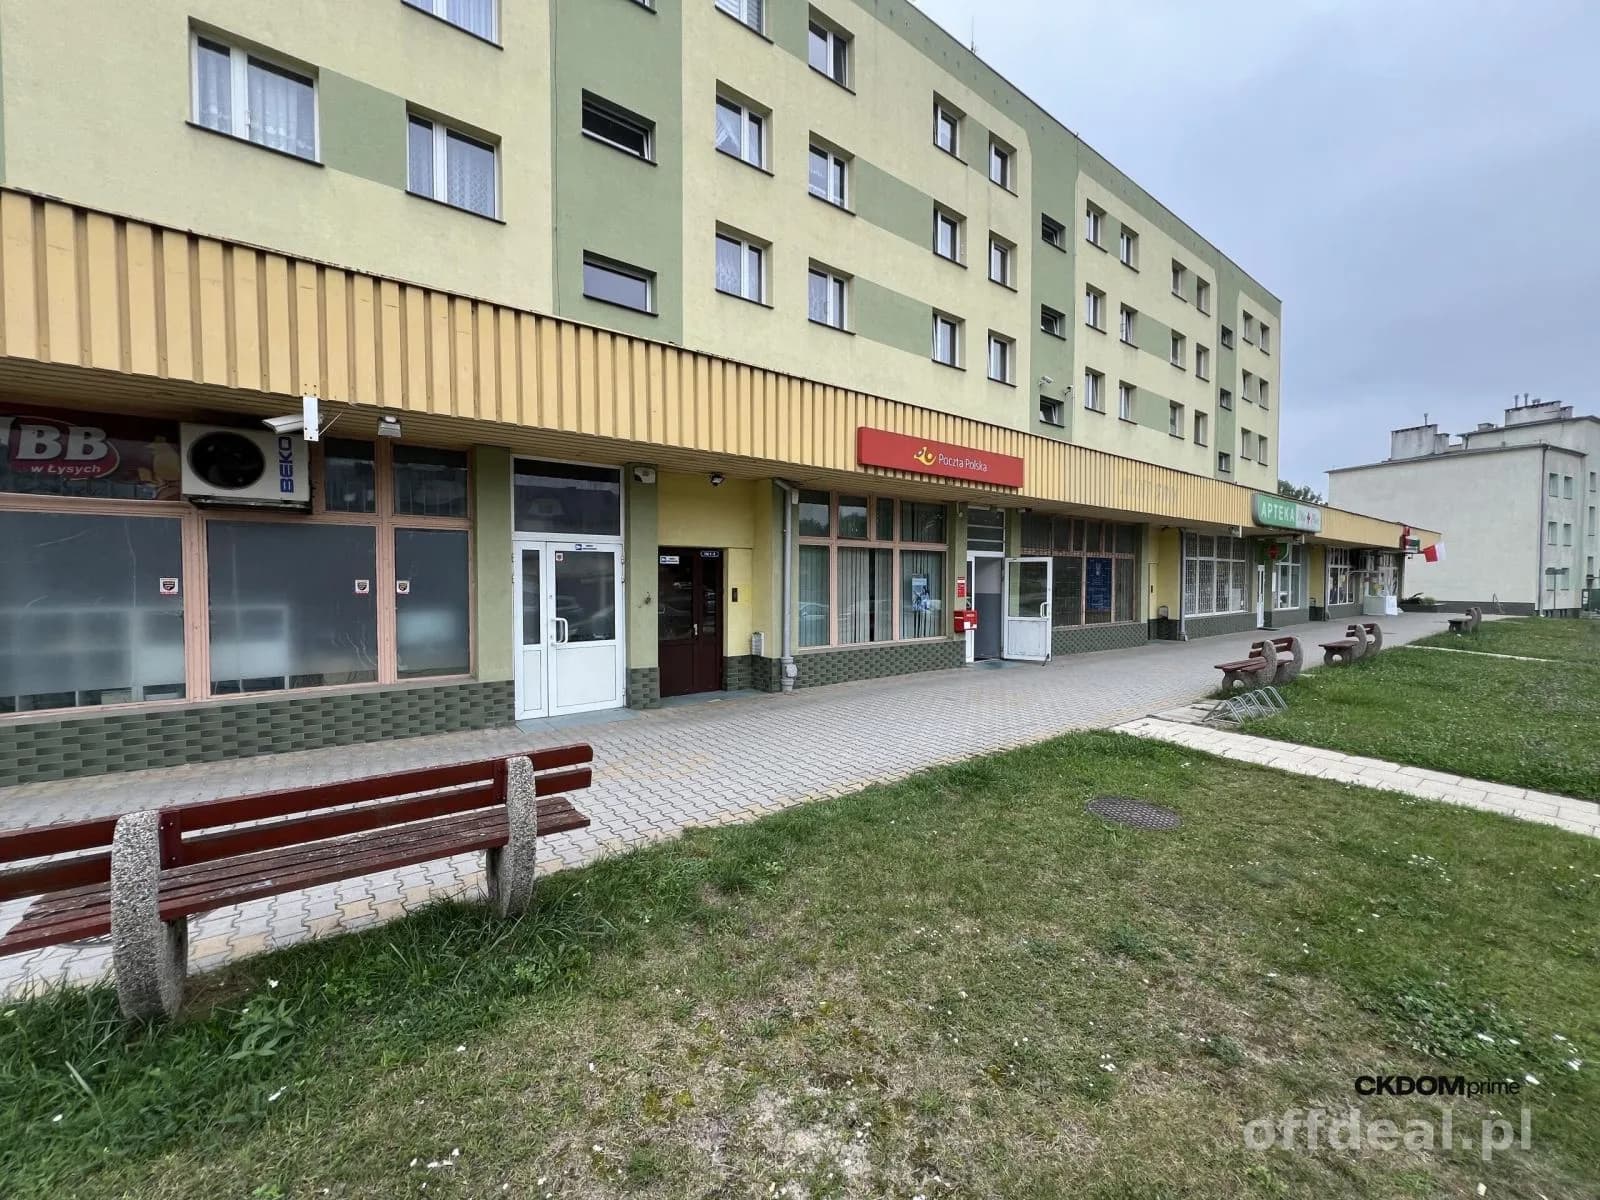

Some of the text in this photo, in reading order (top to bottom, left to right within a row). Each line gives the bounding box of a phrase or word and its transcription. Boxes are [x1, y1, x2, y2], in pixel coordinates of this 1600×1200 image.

[47, 464, 101, 475] Łysych
[279, 436, 294, 493] BEKO
[938, 453, 988, 472] Poczta Polska
[1260, 501, 1295, 523] APTEKA
